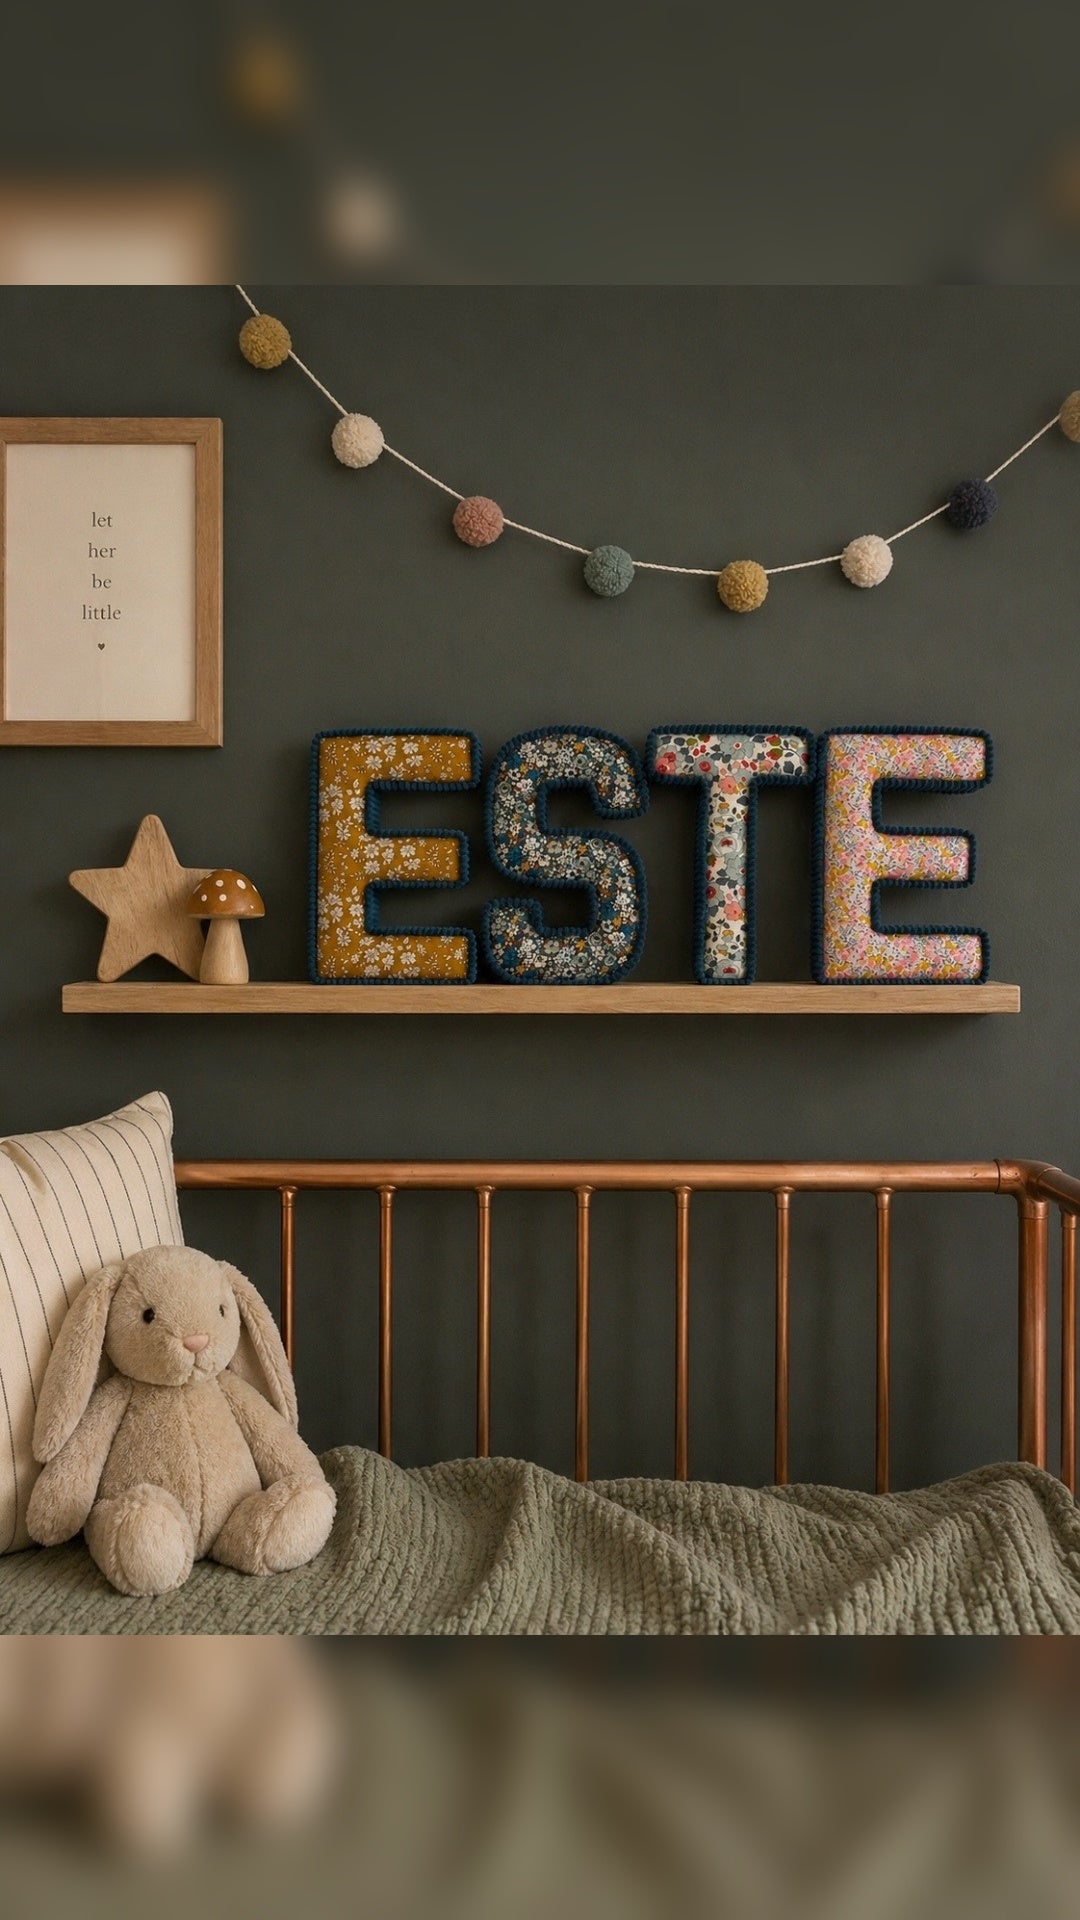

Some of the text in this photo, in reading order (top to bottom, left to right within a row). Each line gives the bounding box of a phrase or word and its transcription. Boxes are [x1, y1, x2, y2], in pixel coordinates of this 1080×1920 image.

[91, 511, 113, 528] let
[88, 542, 117, 559] her
[91, 573, 112, 590] be
[82, 604, 122, 621] little
[309, 724, 993, 985] ESTE
